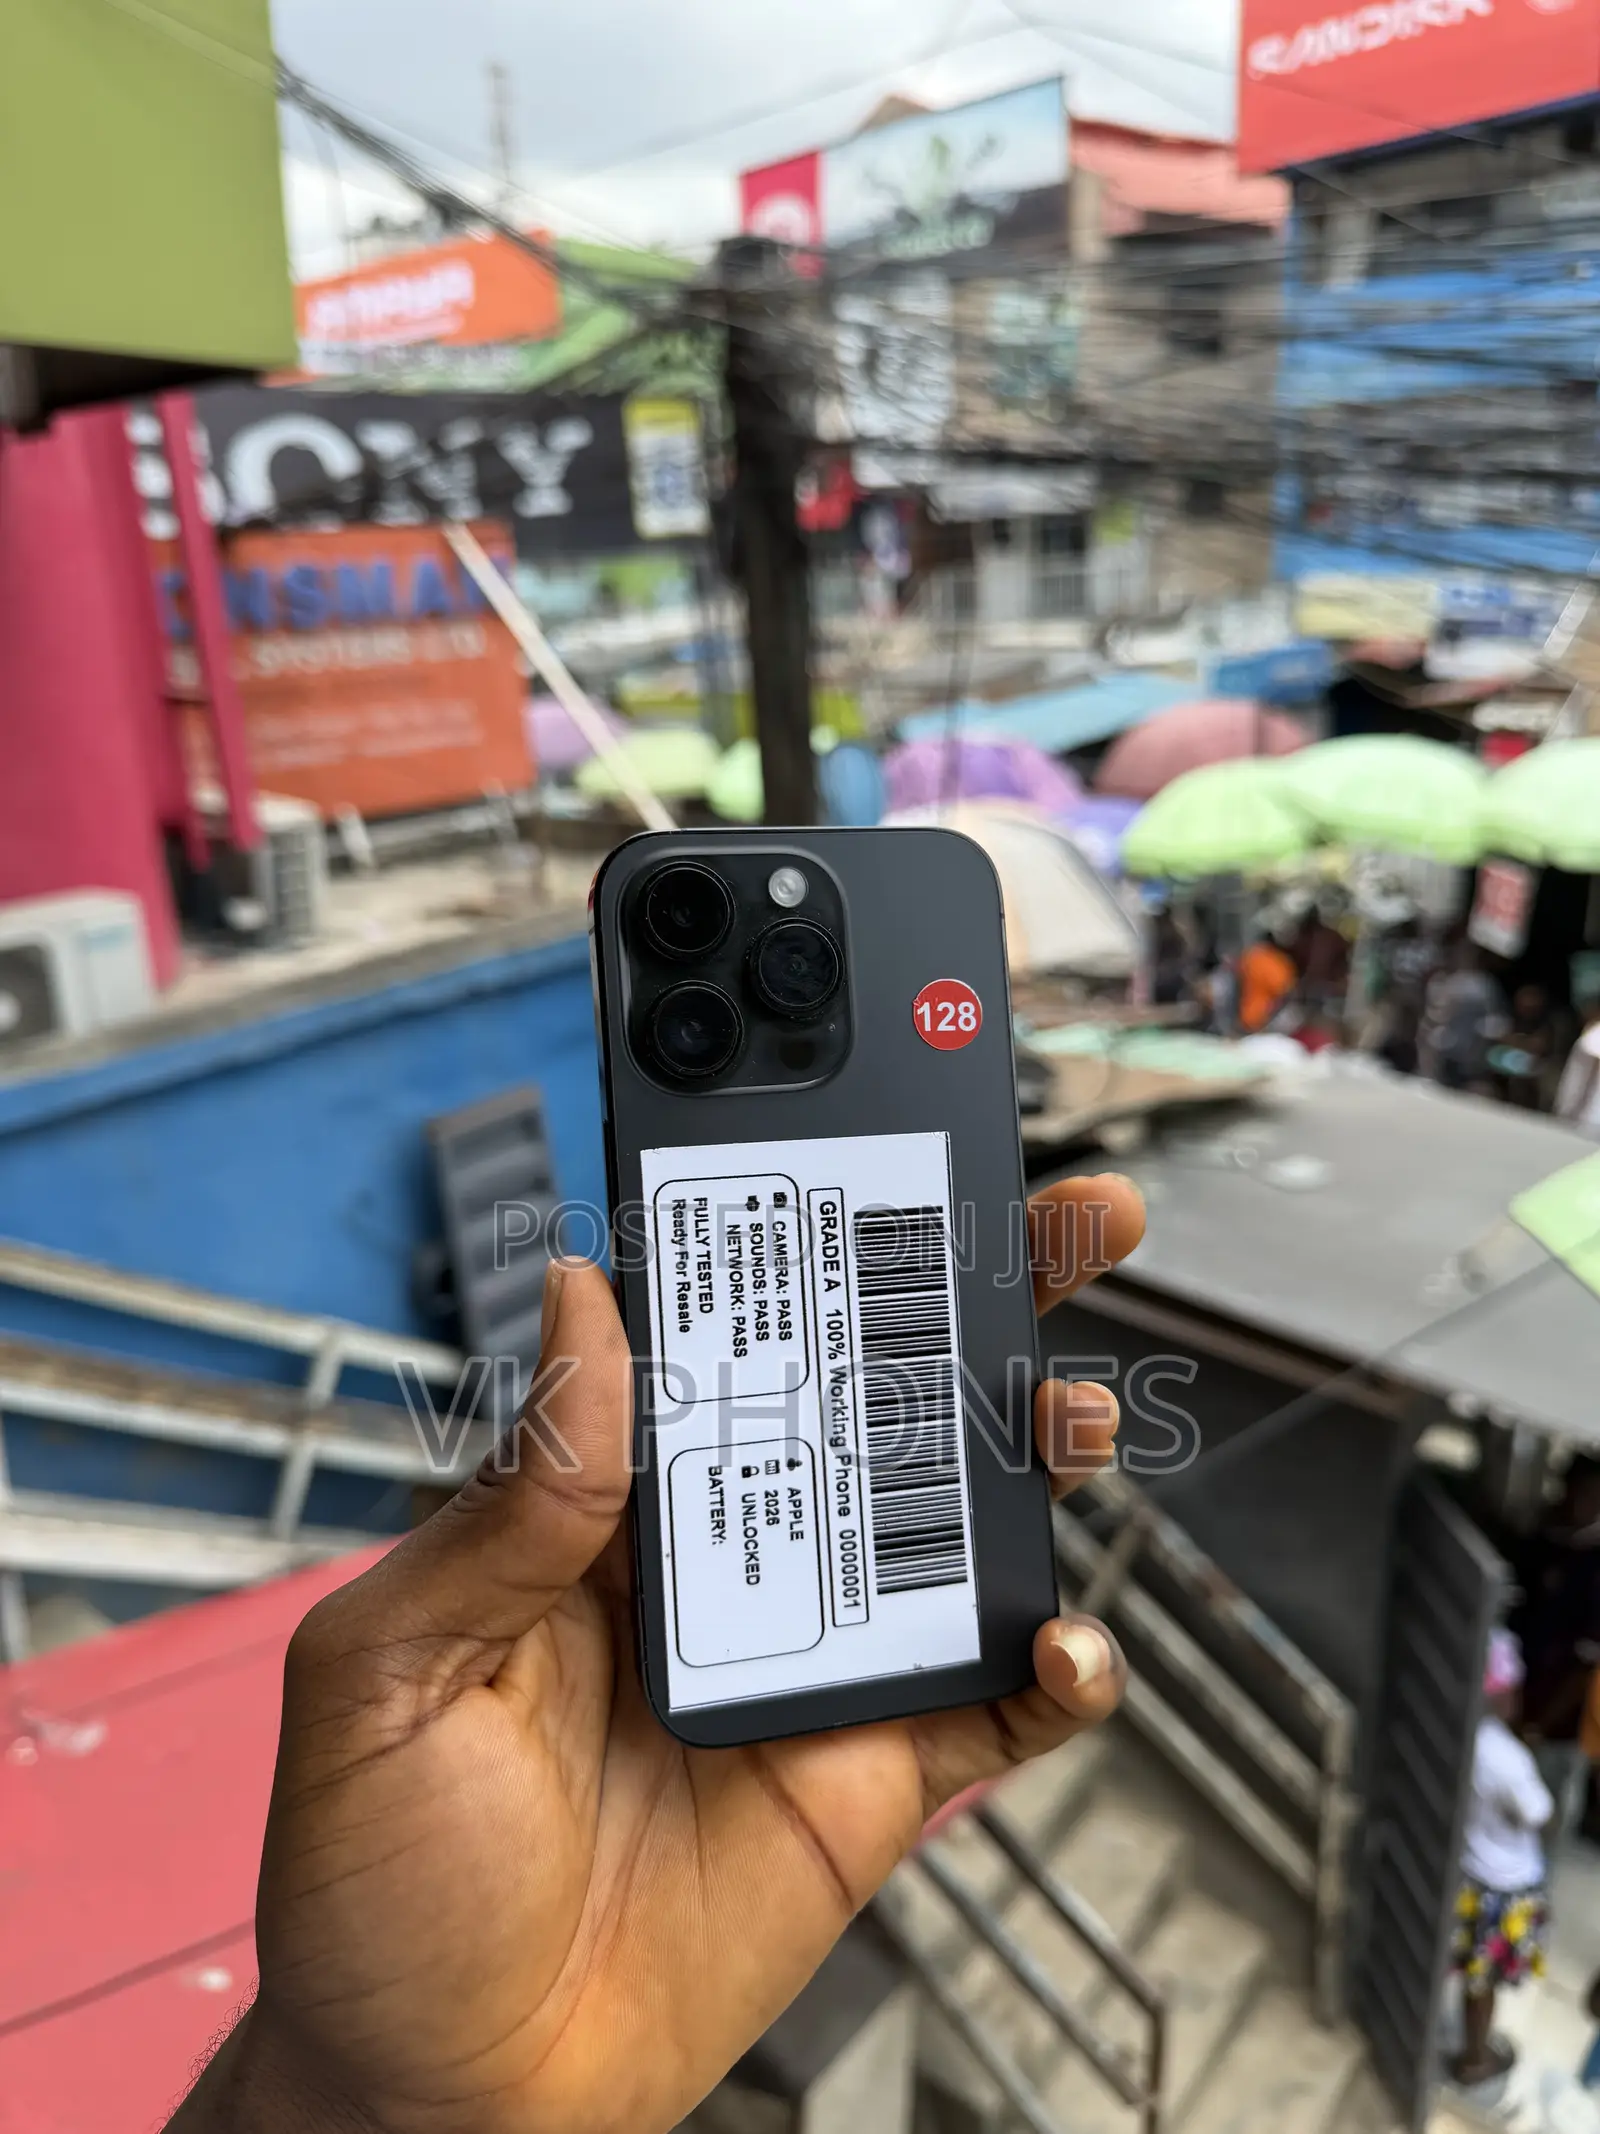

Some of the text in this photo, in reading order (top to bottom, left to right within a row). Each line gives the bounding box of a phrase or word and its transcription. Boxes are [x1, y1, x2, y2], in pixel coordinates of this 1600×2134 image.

[917, 1001, 976, 1031] 128
[671, 1198, 693, 1334] Ready For Resale
[692, 1197, 714, 1314] FULLY TESTED
[726, 1224, 748, 1358] NETWORK: PASS
[749, 1222, 770, 1342] SOUNDS: PASS
[771, 1220, 792, 1341] CAMERA: PASS
[819, 1200, 861, 1608] GRADE A 100% Working Phone 0000001
[707, 1465, 727, 1546] BATTERY:
[741, 1492, 761, 1586] UNLOCKED
[764, 1490, 781, 1526] 2026
[786, 1486, 805, 1541] APPLE
